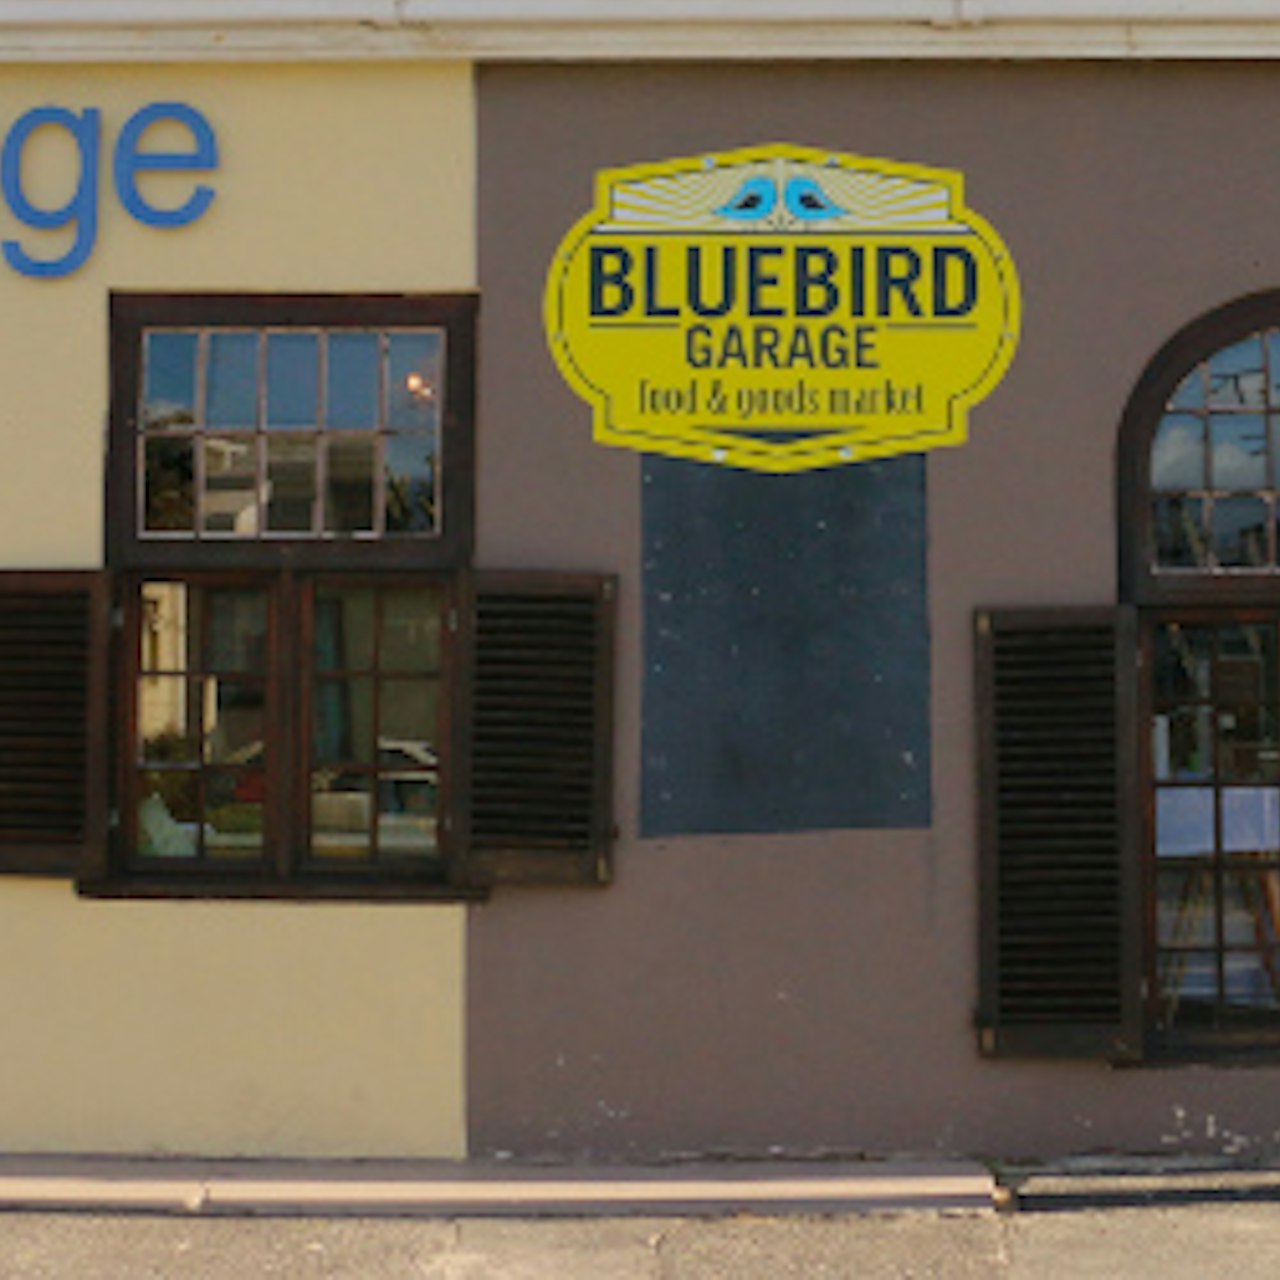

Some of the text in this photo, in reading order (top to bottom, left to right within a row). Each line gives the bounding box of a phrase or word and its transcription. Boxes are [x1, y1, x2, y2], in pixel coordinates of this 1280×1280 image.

[588, 245, 979, 318] BLUEBIRD
[685, 324, 880, 368] GARAGE
[638, 378, 924, 420] food & goods market
